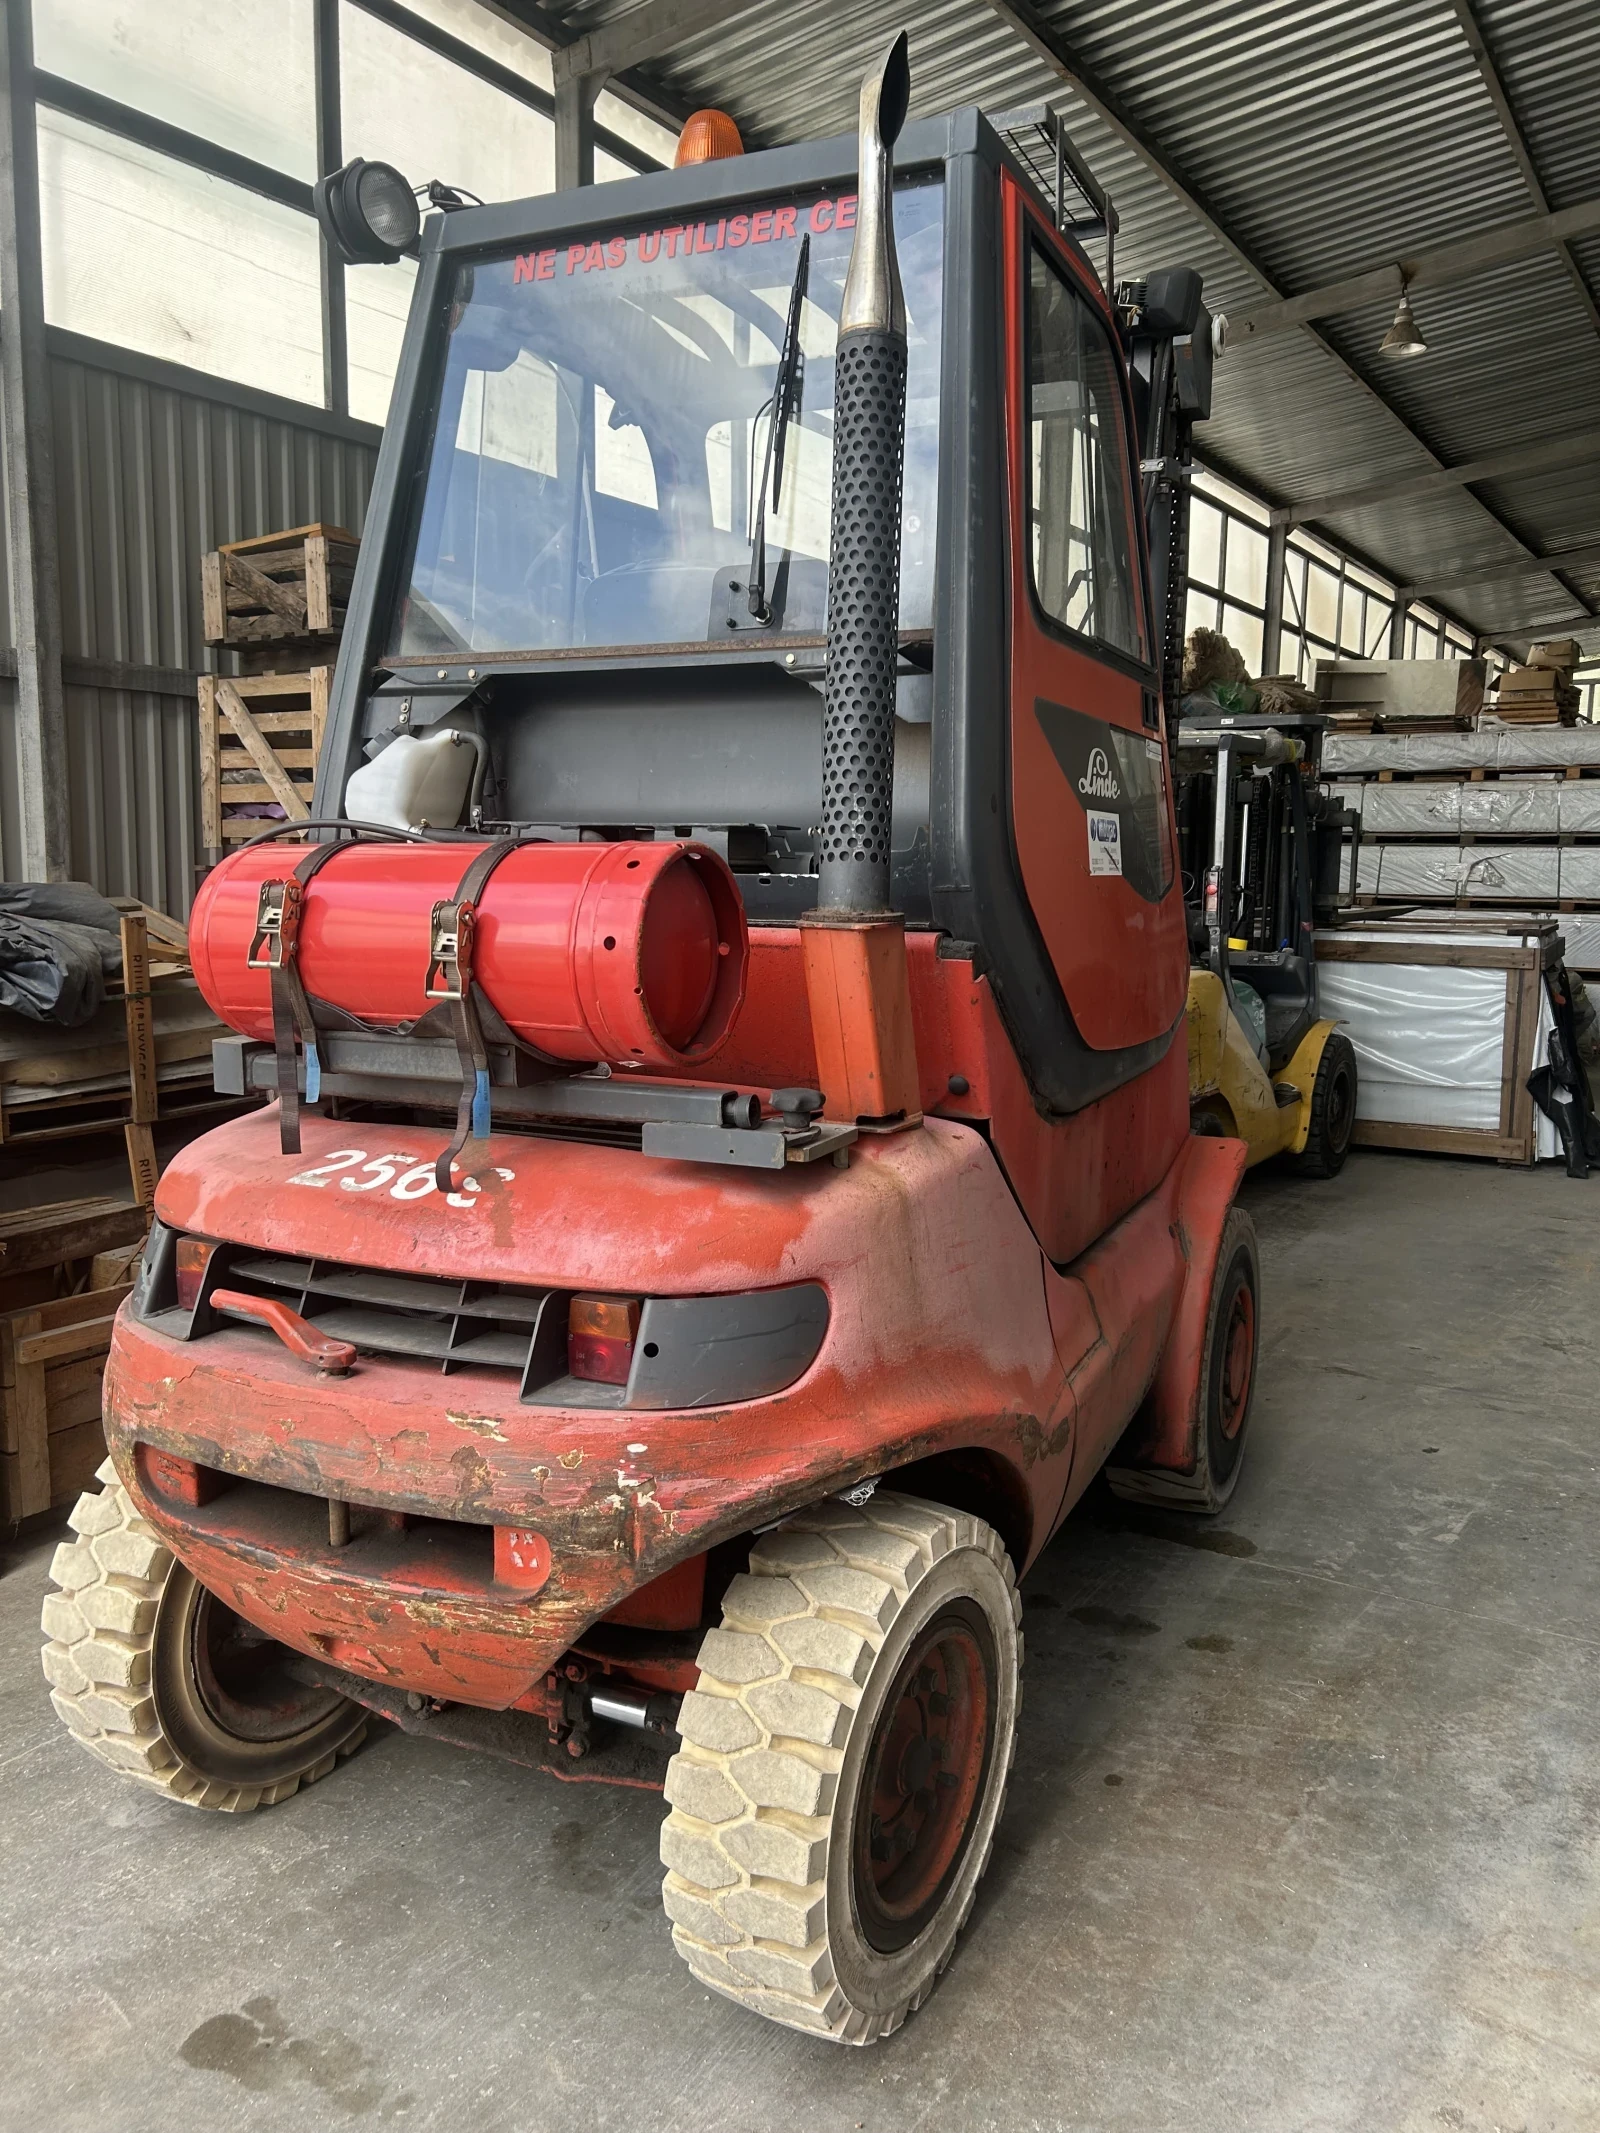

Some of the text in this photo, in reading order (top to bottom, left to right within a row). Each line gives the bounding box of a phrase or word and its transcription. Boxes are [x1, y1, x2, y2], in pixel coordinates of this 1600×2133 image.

[513, 248, 556, 284] NE
[565, 236, 627, 276] PAS
[638, 206, 798, 264] UTILISER
[809, 194, 859, 235] CE
[1078, 747, 1121, 800] Linde
